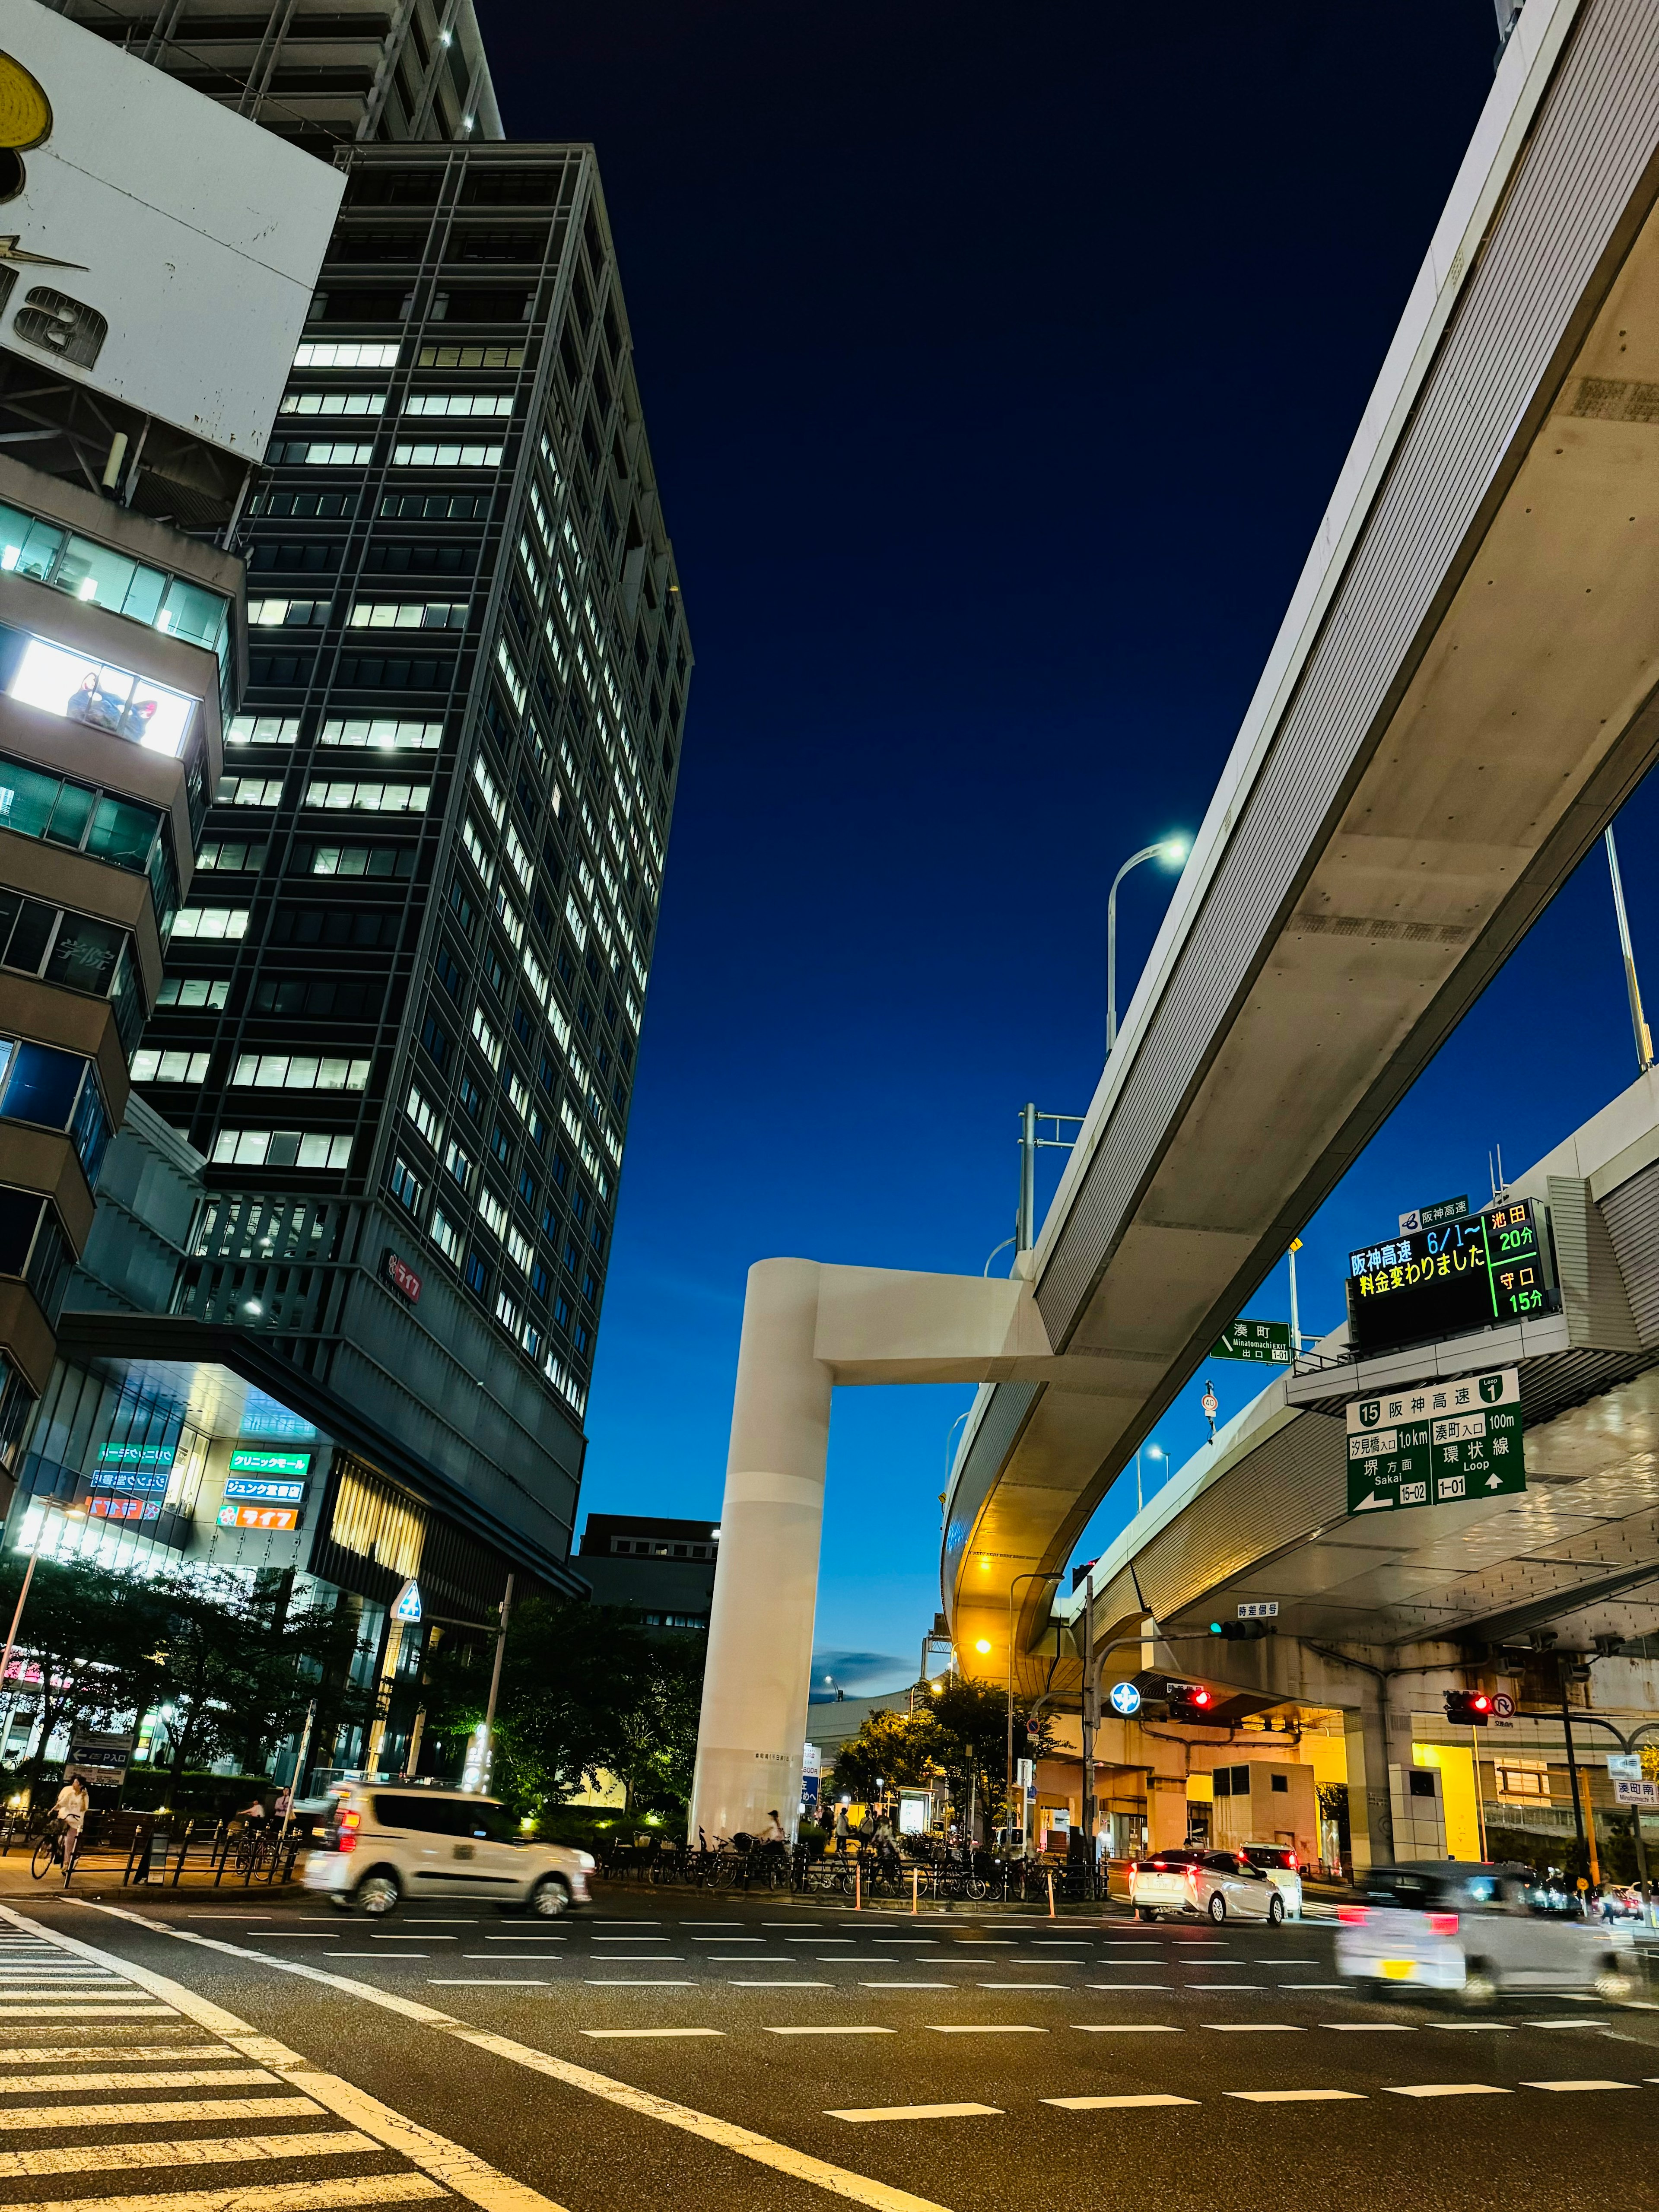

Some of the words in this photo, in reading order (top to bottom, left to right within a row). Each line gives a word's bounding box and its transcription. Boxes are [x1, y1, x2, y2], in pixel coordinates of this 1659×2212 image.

[56, 938, 115, 970] 学院
[1422, 1201, 1467, 1224] 阪神高速
[1492, 1205, 1526, 1230] 池田
[1500, 1227, 1532, 1251] 20分
[1351, 1240, 1412, 1276] 阪神高速
[1359, 1244, 1485, 1297] 料金変わりました
[1500, 1267, 1534, 1289] 守口
[399, 1264, 419, 1296] ライフ
[1510, 1289, 1542, 1313] 15分
[1234, 1323, 1270, 1338] 湊町
[1243, 1350, 1263, 1358] 出口
[1274, 1351, 1287, 1360] 1-01
[1488, 1385, 1495, 1401] 1
[1362, 1404, 1378, 1421] 15
[1389, 1388, 1470, 1418] 阪神高速
[1490, 1414, 1514, 1430] 100m
[1444, 1437, 1509, 1463] 環状線
[235, 1454, 305, 1470] クリニックモール
[1464, 1461, 1489, 1471] Loop
[1375, 1473, 1402, 1486] Sakai
[1440, 1479, 1464, 1494] 1-01
[1402, 1486, 1424, 1500] 15-02
[242, 1510, 292, 1526] ライフ
[1239, 1605, 1277, 1616] 時差信号
[1618, 1783, 1654, 1795] 湊町南
